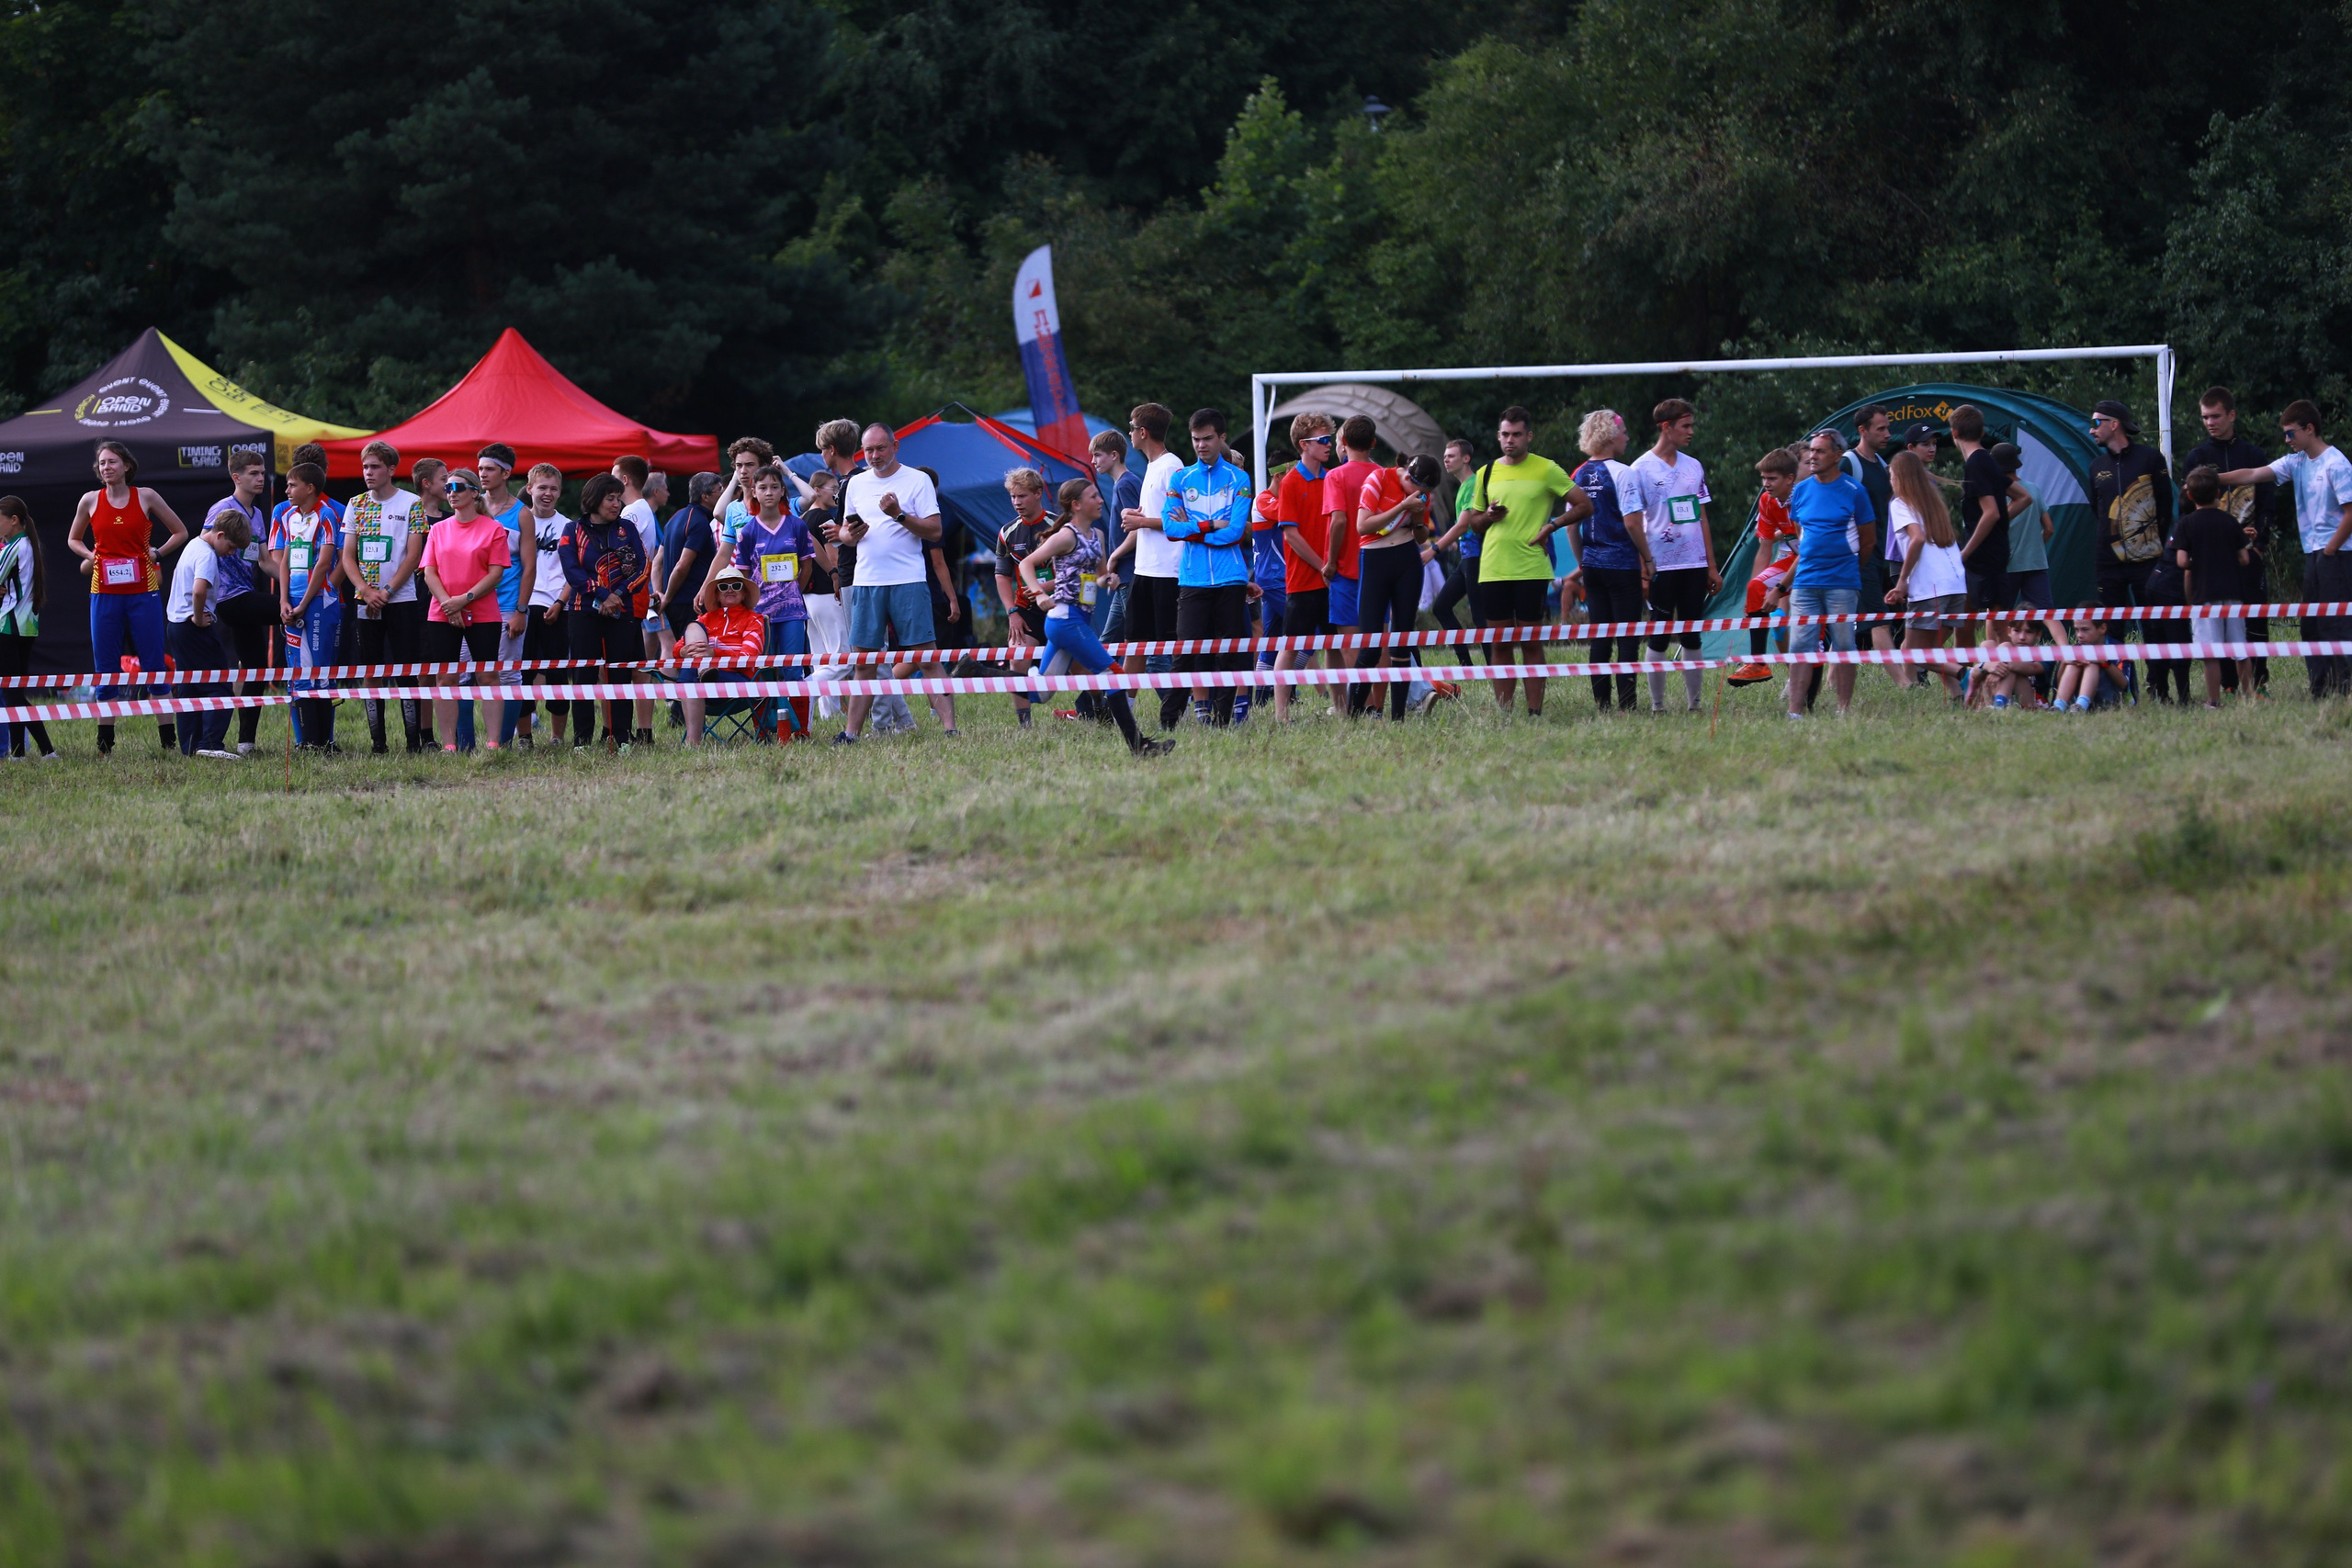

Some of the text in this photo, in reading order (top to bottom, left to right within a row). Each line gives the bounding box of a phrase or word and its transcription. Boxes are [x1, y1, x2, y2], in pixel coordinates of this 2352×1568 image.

[101, 396, 152, 407] OPEN
[96, 403, 141, 414] BAND
[1886, 405, 1932, 422] edFox
[0, 451, 24, 462] PEN
[181, 446, 222, 457] TIMING
[0, 462, 21, 473] AND
[192, 457, 221, 468] BAND
[771, 564, 787, 572] 232.3
